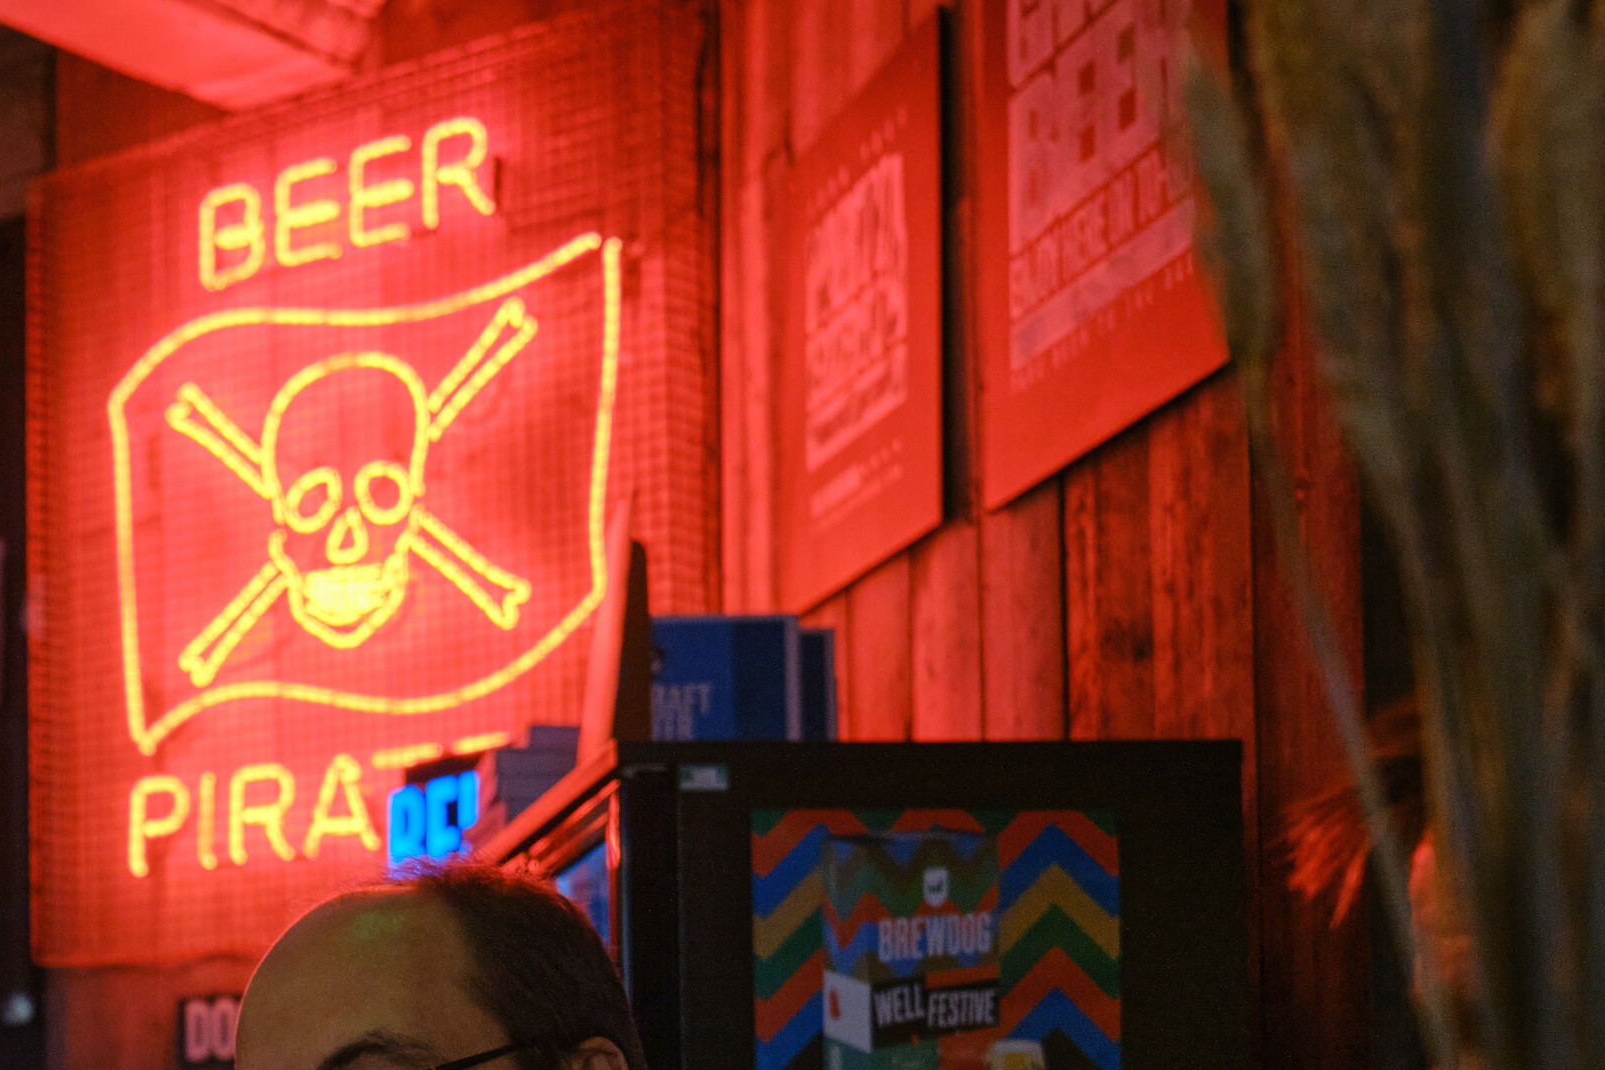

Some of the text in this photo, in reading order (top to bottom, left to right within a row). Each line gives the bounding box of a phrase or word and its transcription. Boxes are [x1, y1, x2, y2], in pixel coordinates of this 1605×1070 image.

[198, 116, 496, 292] BEER
[651, 682, 712, 717] RAFT
[128, 731, 511, 878] PIRA
[878, 910, 993, 963] BREWDOG
[186, 997, 237, 1062] DO
[875, 984, 995, 1028] WELL FESTIVE
